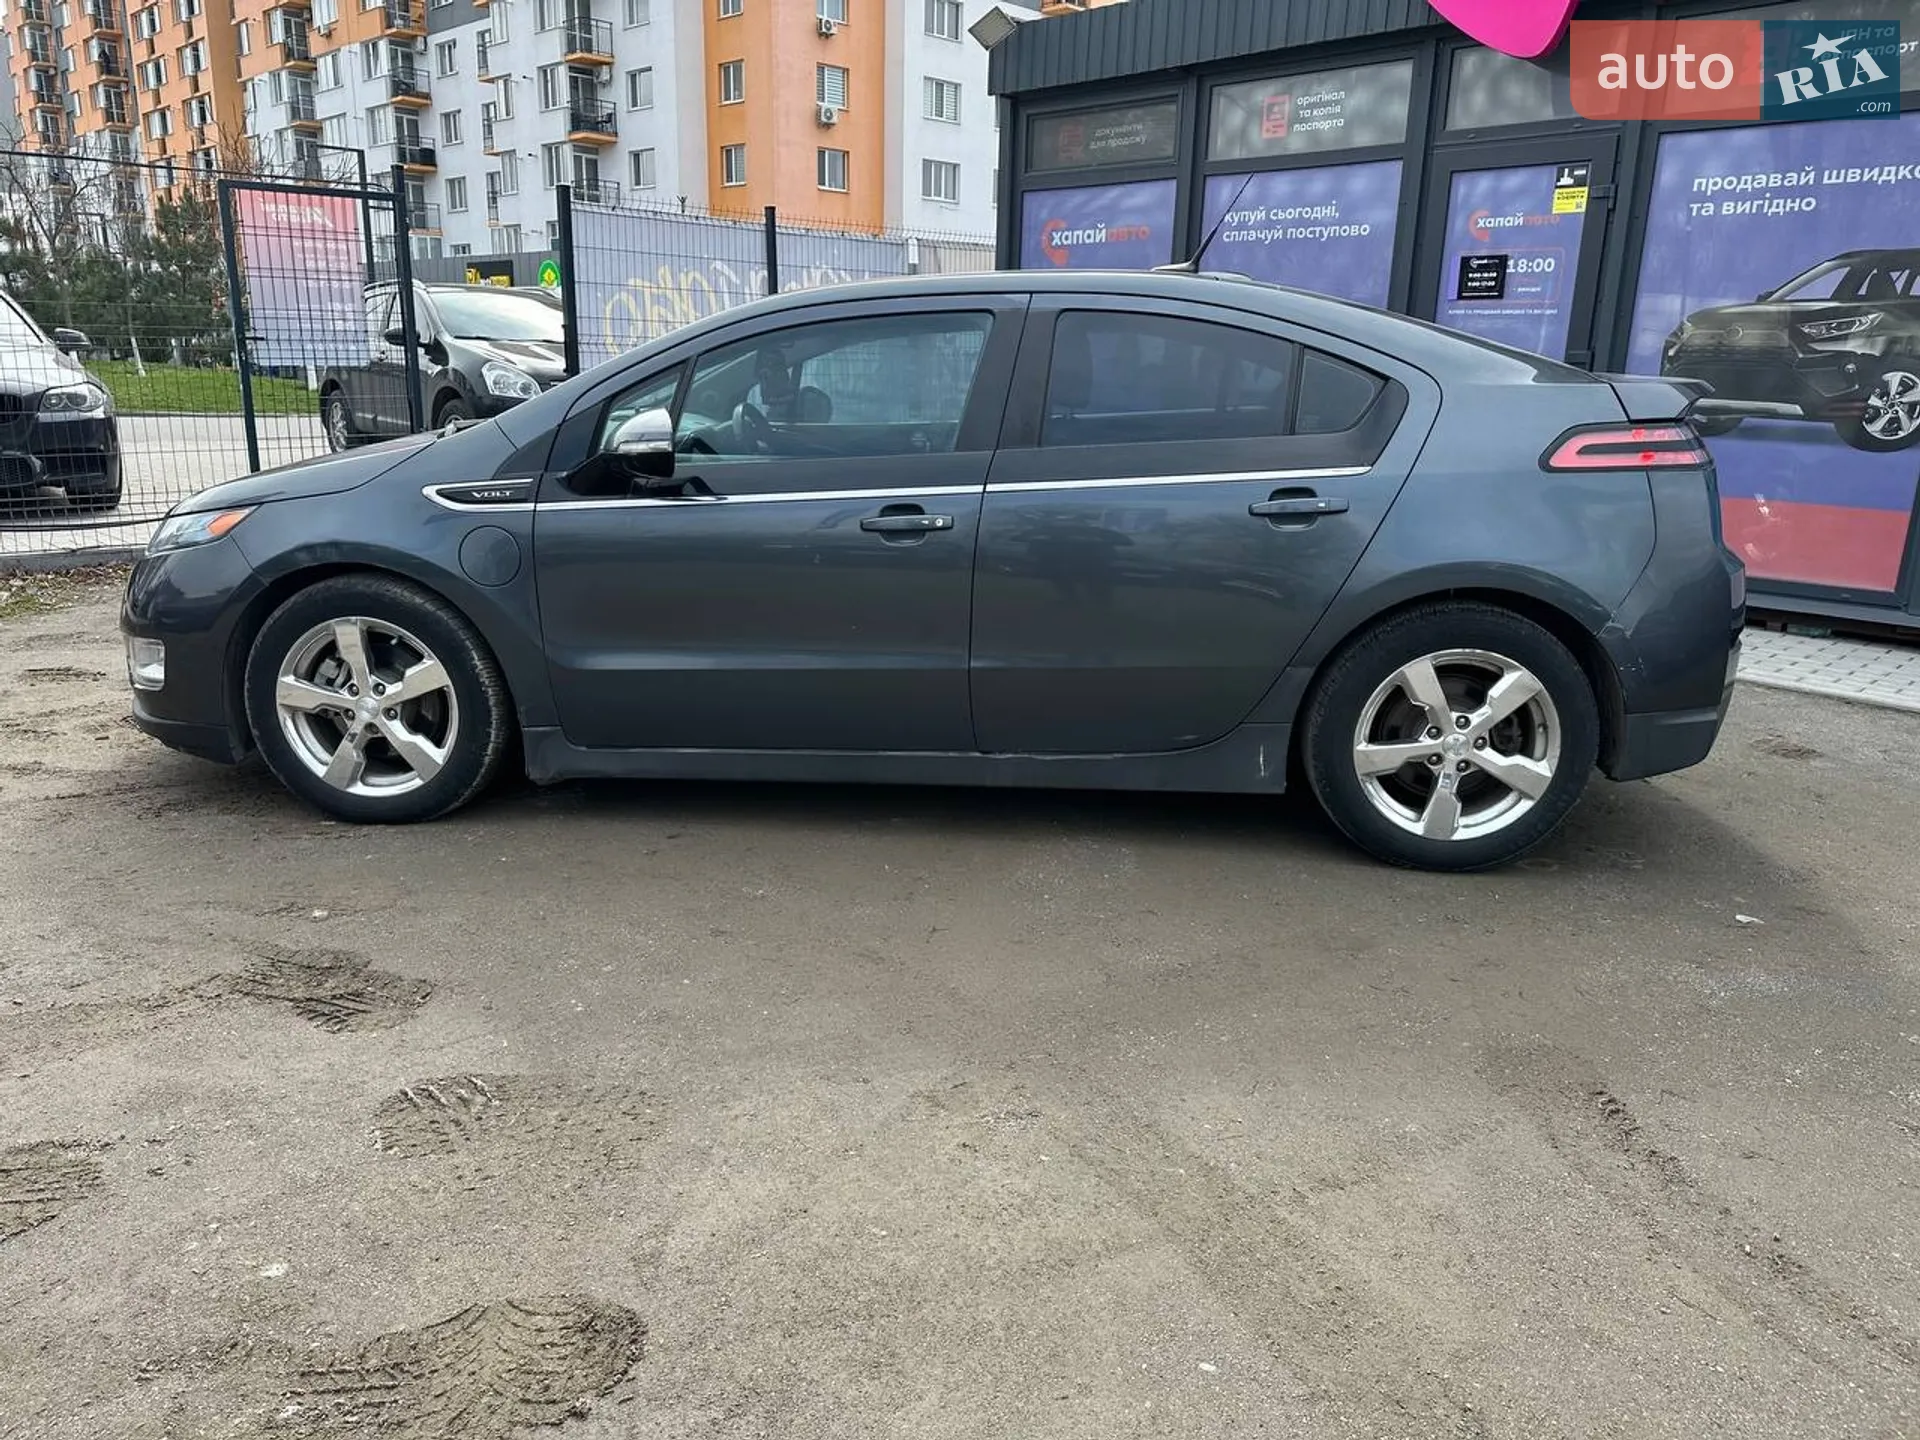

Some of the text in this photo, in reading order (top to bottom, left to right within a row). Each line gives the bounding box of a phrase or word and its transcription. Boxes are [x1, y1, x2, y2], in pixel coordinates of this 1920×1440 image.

[1874, 26, 1896, 38] та
[1297, 90, 1346, 106] оригінал
[1299, 103, 1342, 118] та копія
[1293, 118, 1345, 132] паспорта
[1692, 165, 1816, 195] продавай
[1689, 192, 1817, 217] та вигідно
[1224, 200, 1340, 227] купуй сьогодні,
[1222, 224, 1370, 245] сплачуй поступово
[1506, 257, 1556, 273] 18:00
[471, 490, 514, 498] VOLT
